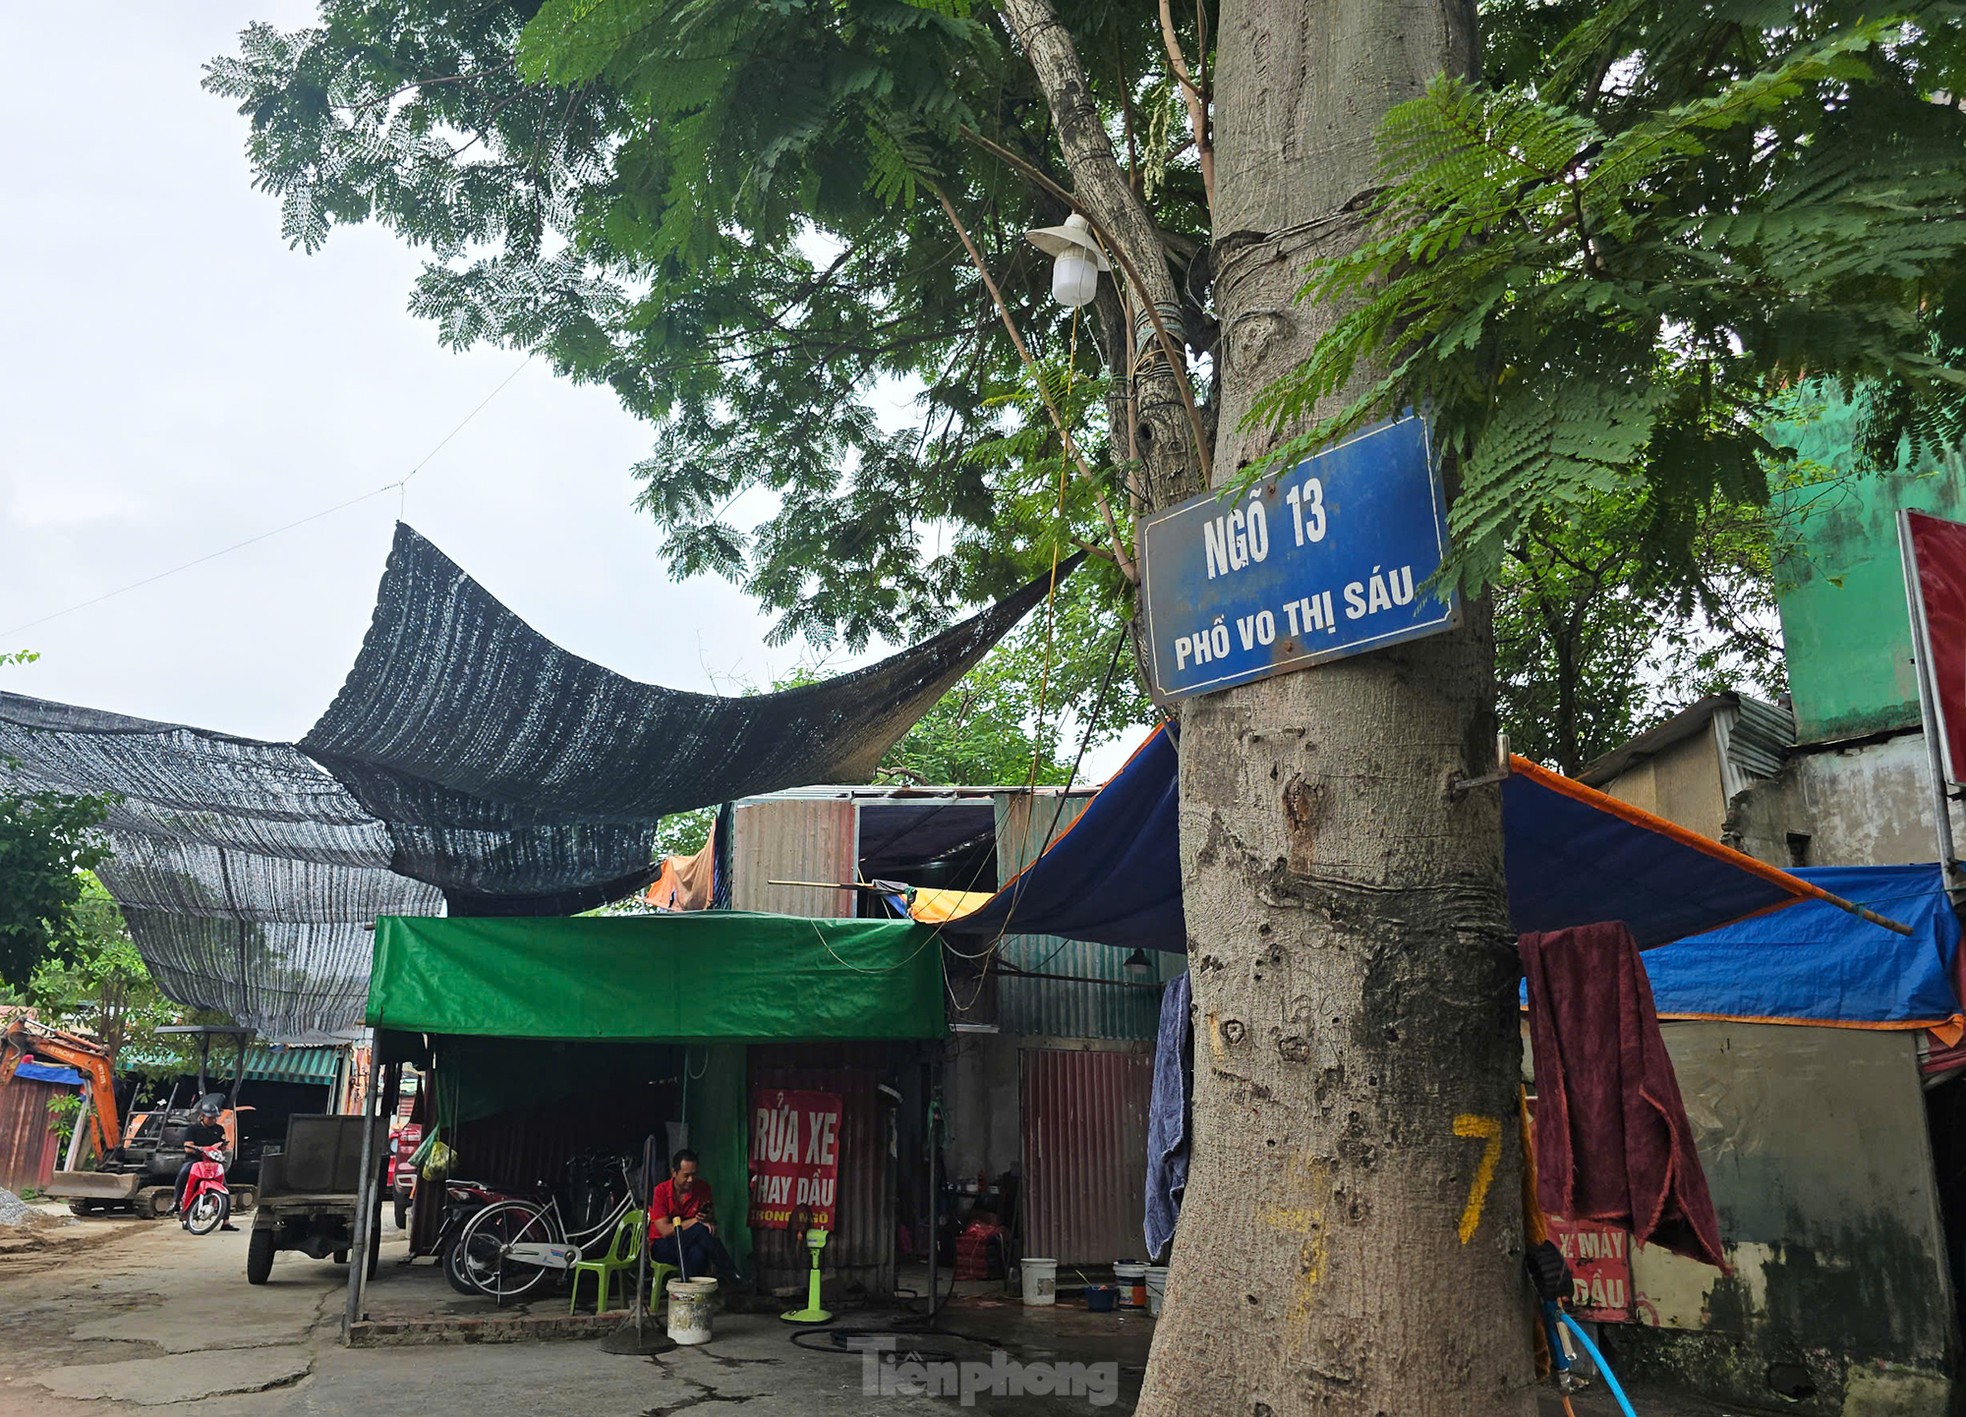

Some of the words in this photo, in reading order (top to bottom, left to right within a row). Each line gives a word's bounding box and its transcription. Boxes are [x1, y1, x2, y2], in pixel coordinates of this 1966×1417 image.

[1203, 487, 1269, 580] NGÕ
[1286, 477, 1327, 547] 13
[1283, 590, 1336, 637] THỊ
[1343, 565, 1414, 620] SÁU
[754, 1091, 799, 1163] RỬA
[805, 1111, 837, 1165] XE
[796, 1168, 835, 1207] DẦU
[1452, 1114, 1501, 1245] 7
[1578, 1226, 1623, 1259] MÁY
[1572, 1268, 1625, 1308] DẦU
